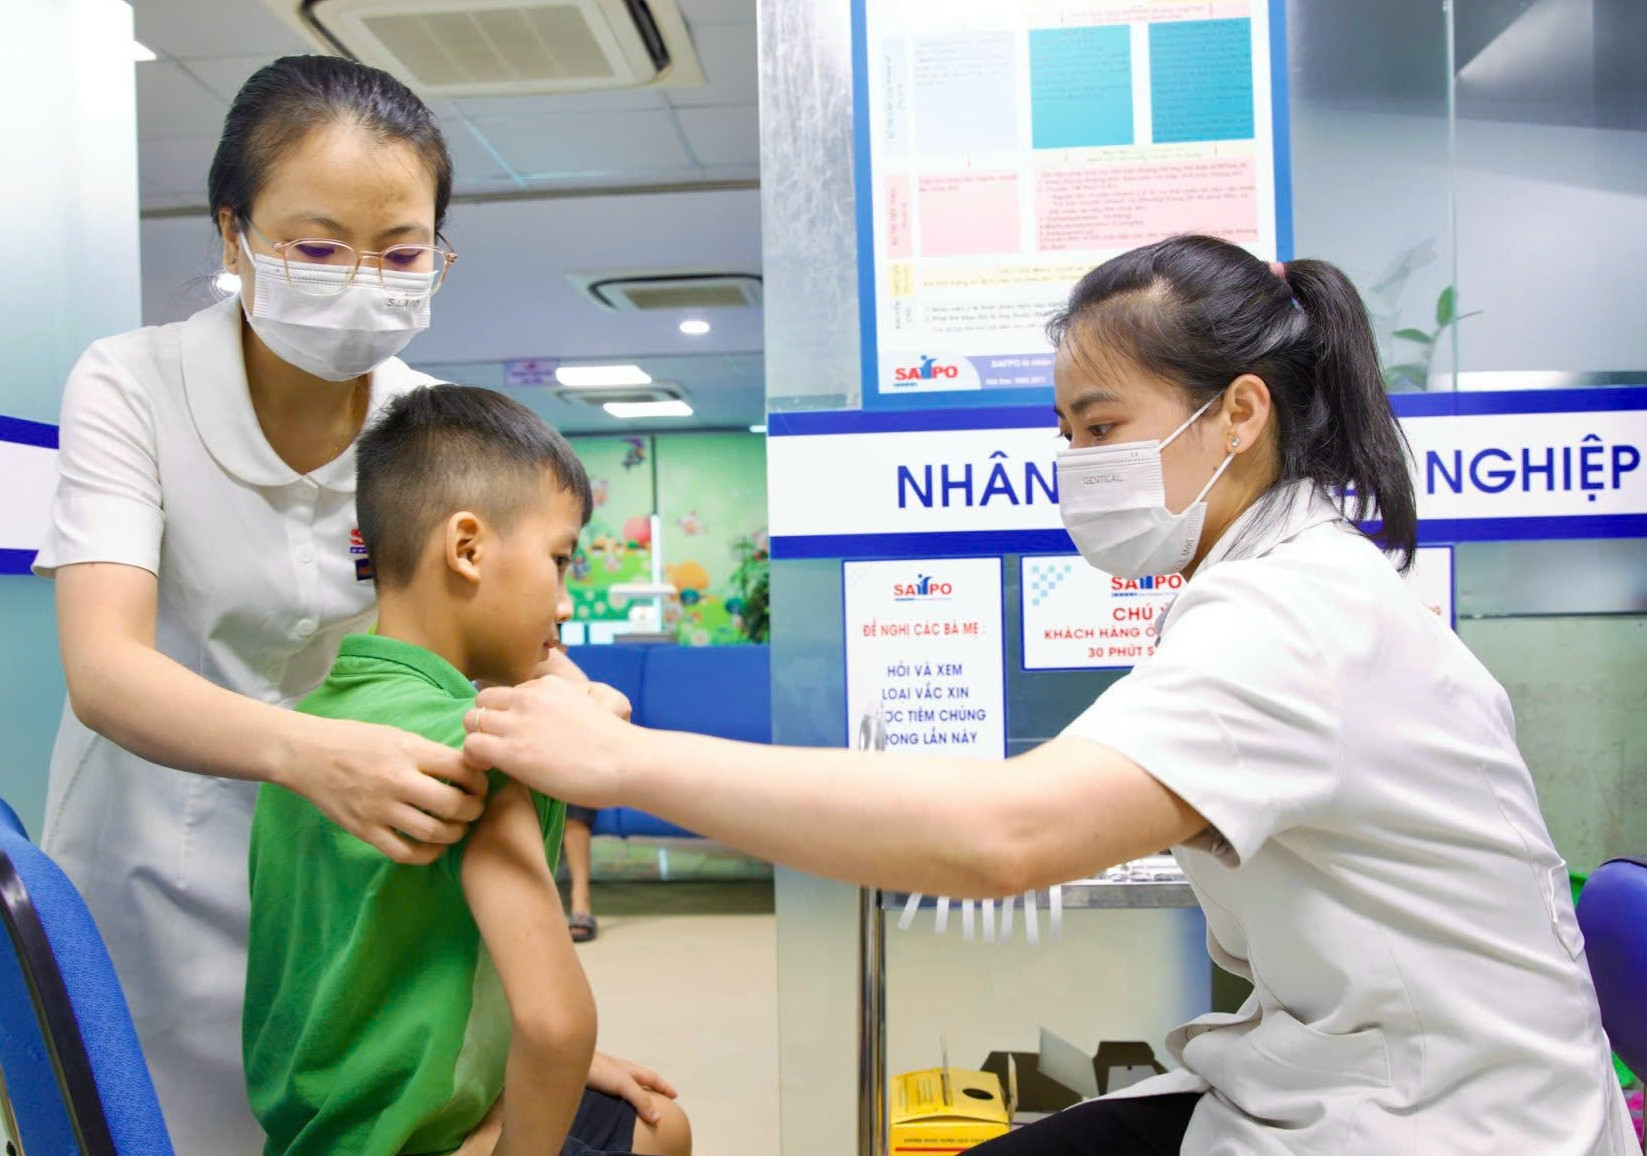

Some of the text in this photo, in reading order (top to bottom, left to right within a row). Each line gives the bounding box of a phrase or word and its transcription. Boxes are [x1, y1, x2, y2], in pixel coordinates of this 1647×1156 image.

[897, 433, 1642, 509] NHÂN NGHIỆP
[1044, 623, 1094, 640] KHÁCH
[1087, 646, 1104, 658] 30
[1108, 642, 1143, 657] PHÚT
[936, 664, 963, 676] XEM
[947, 686, 970, 699] XIN
[907, 706, 935, 722] TIÊM
